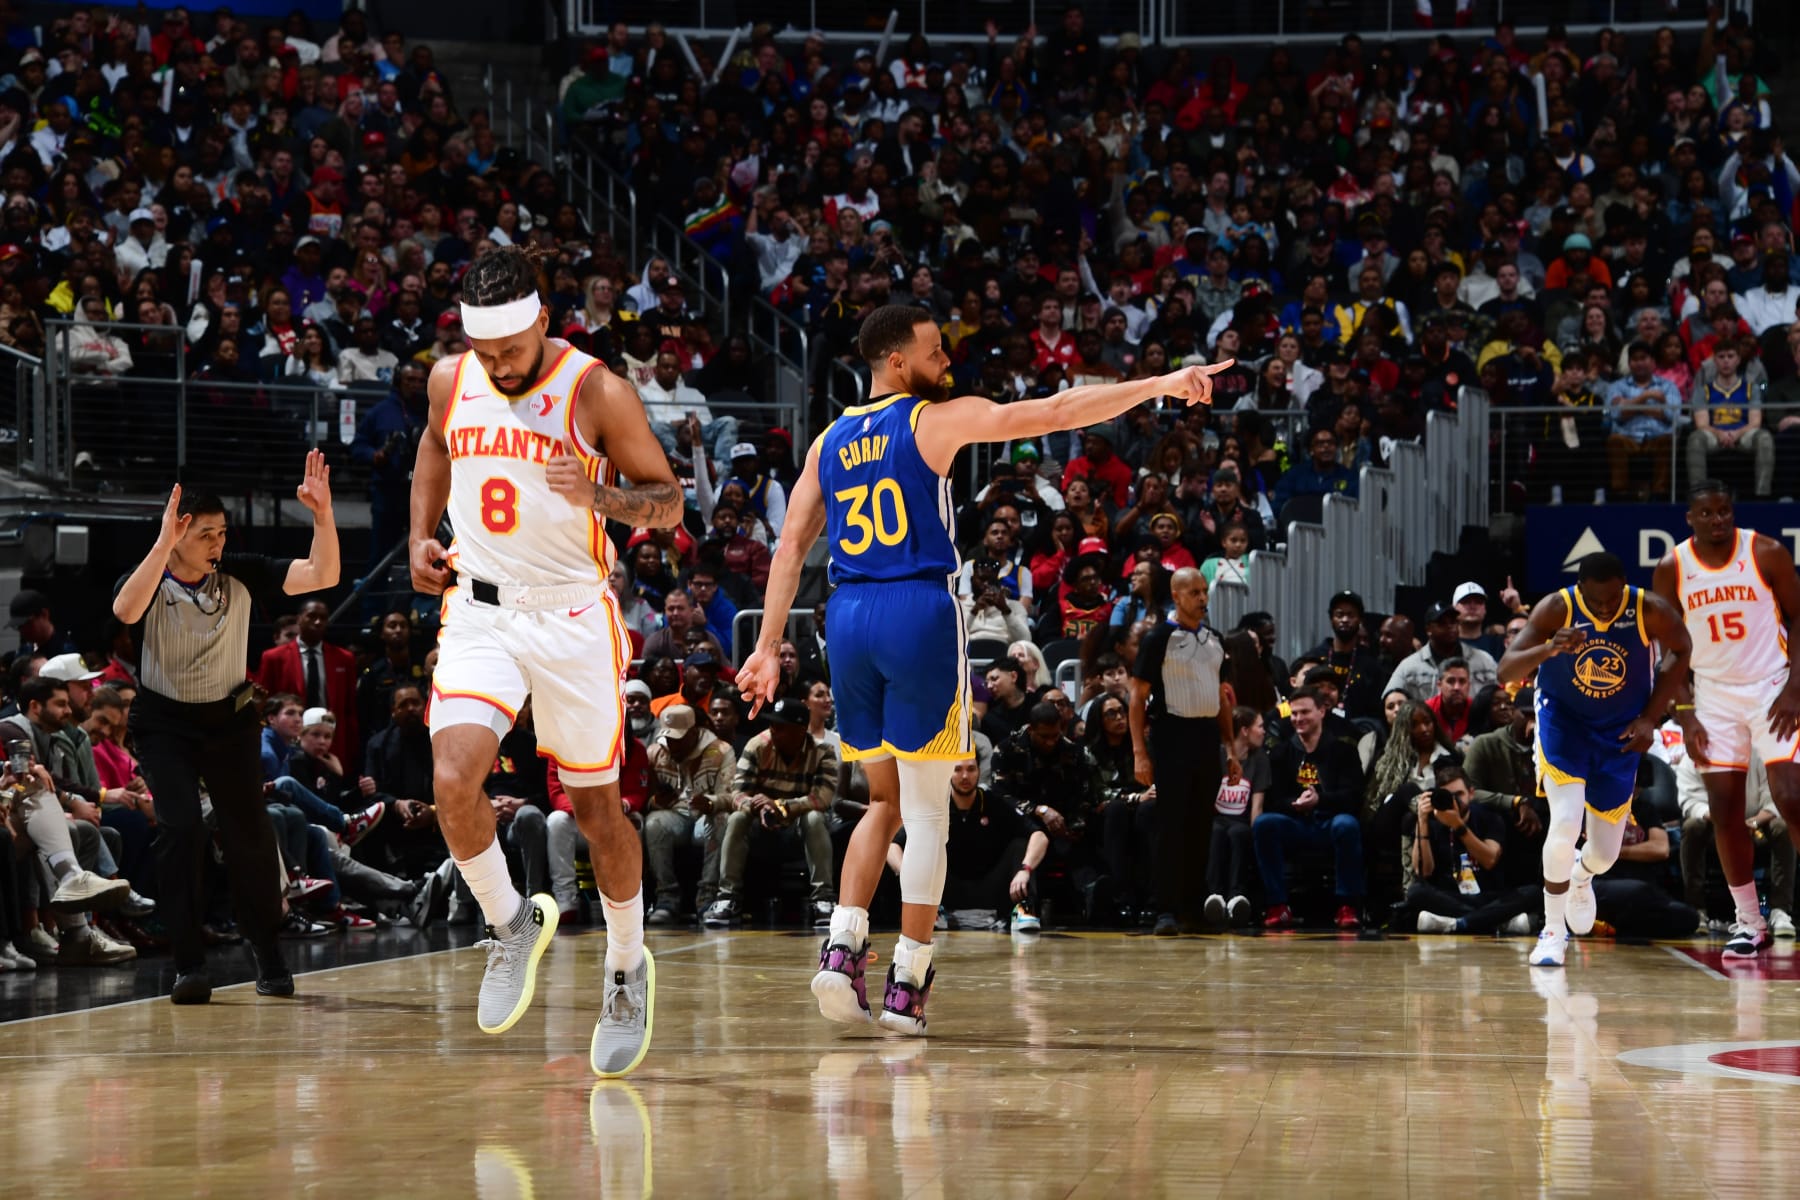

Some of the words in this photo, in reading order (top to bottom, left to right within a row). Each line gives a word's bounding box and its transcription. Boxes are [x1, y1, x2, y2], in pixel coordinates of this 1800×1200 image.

[450, 426, 567, 467] ATLANTA
[838, 434, 889, 471] CURRY
[480, 476, 520, 537] 8
[834, 477, 909, 556] 30
[1687, 585, 1758, 612] ATLANTA
[1706, 611, 1748, 644] 15
[1600, 656, 1621, 671] 23
[1571, 677, 1627, 699] WARRIORS
